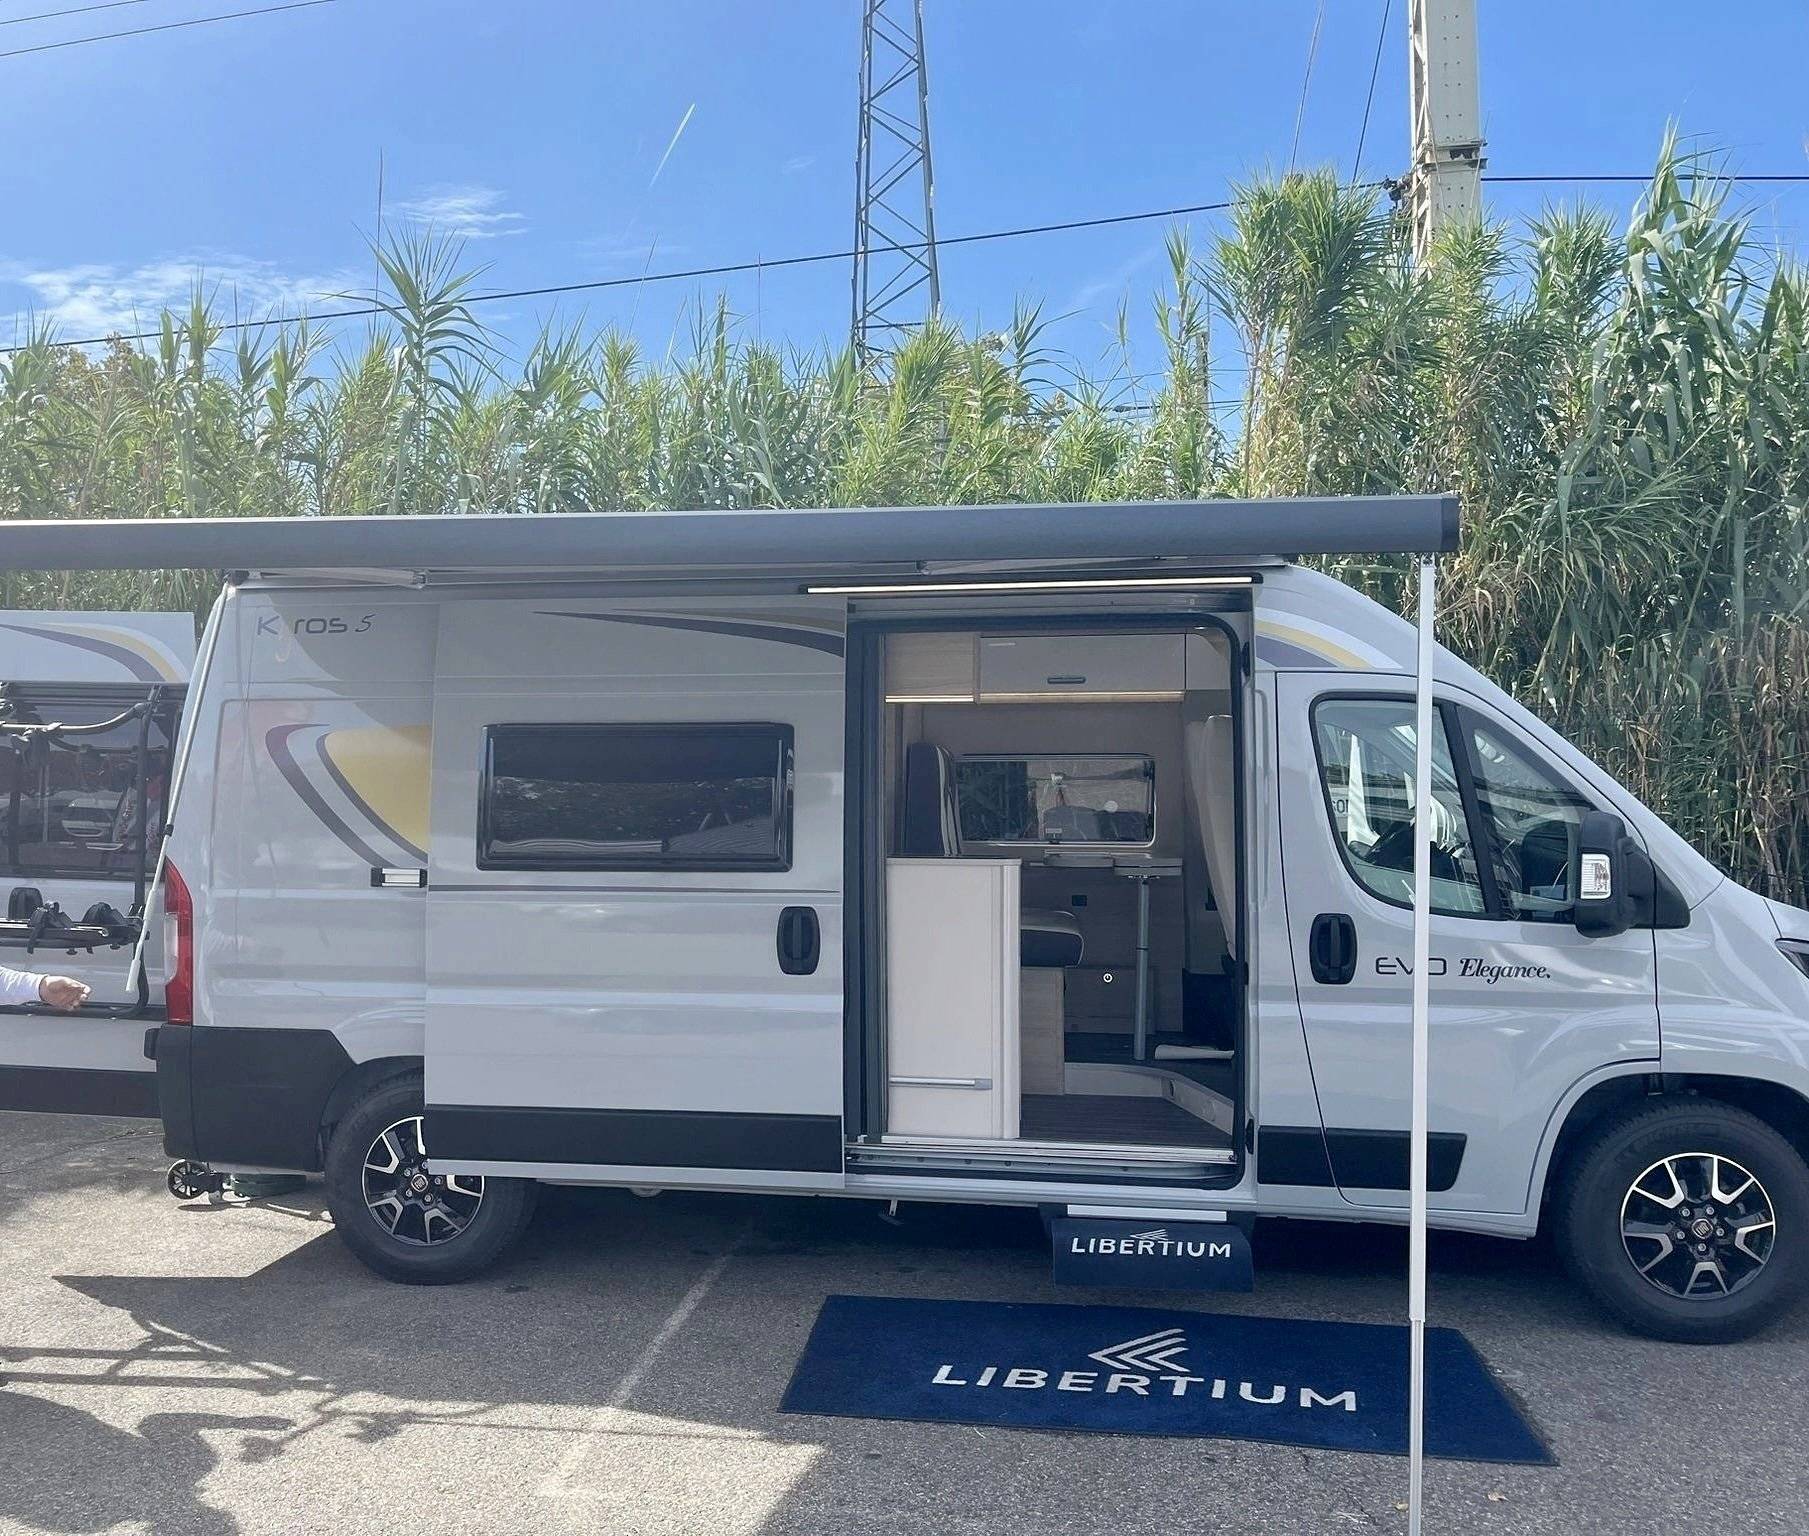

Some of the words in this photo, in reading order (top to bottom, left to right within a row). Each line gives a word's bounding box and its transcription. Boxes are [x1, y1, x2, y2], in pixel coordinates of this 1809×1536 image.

[355, 614, 376, 633] 5
[1071, 1237, 1231, 1258] LIBERTIUM
[931, 1364, 1357, 1412] LIBERTIUM
